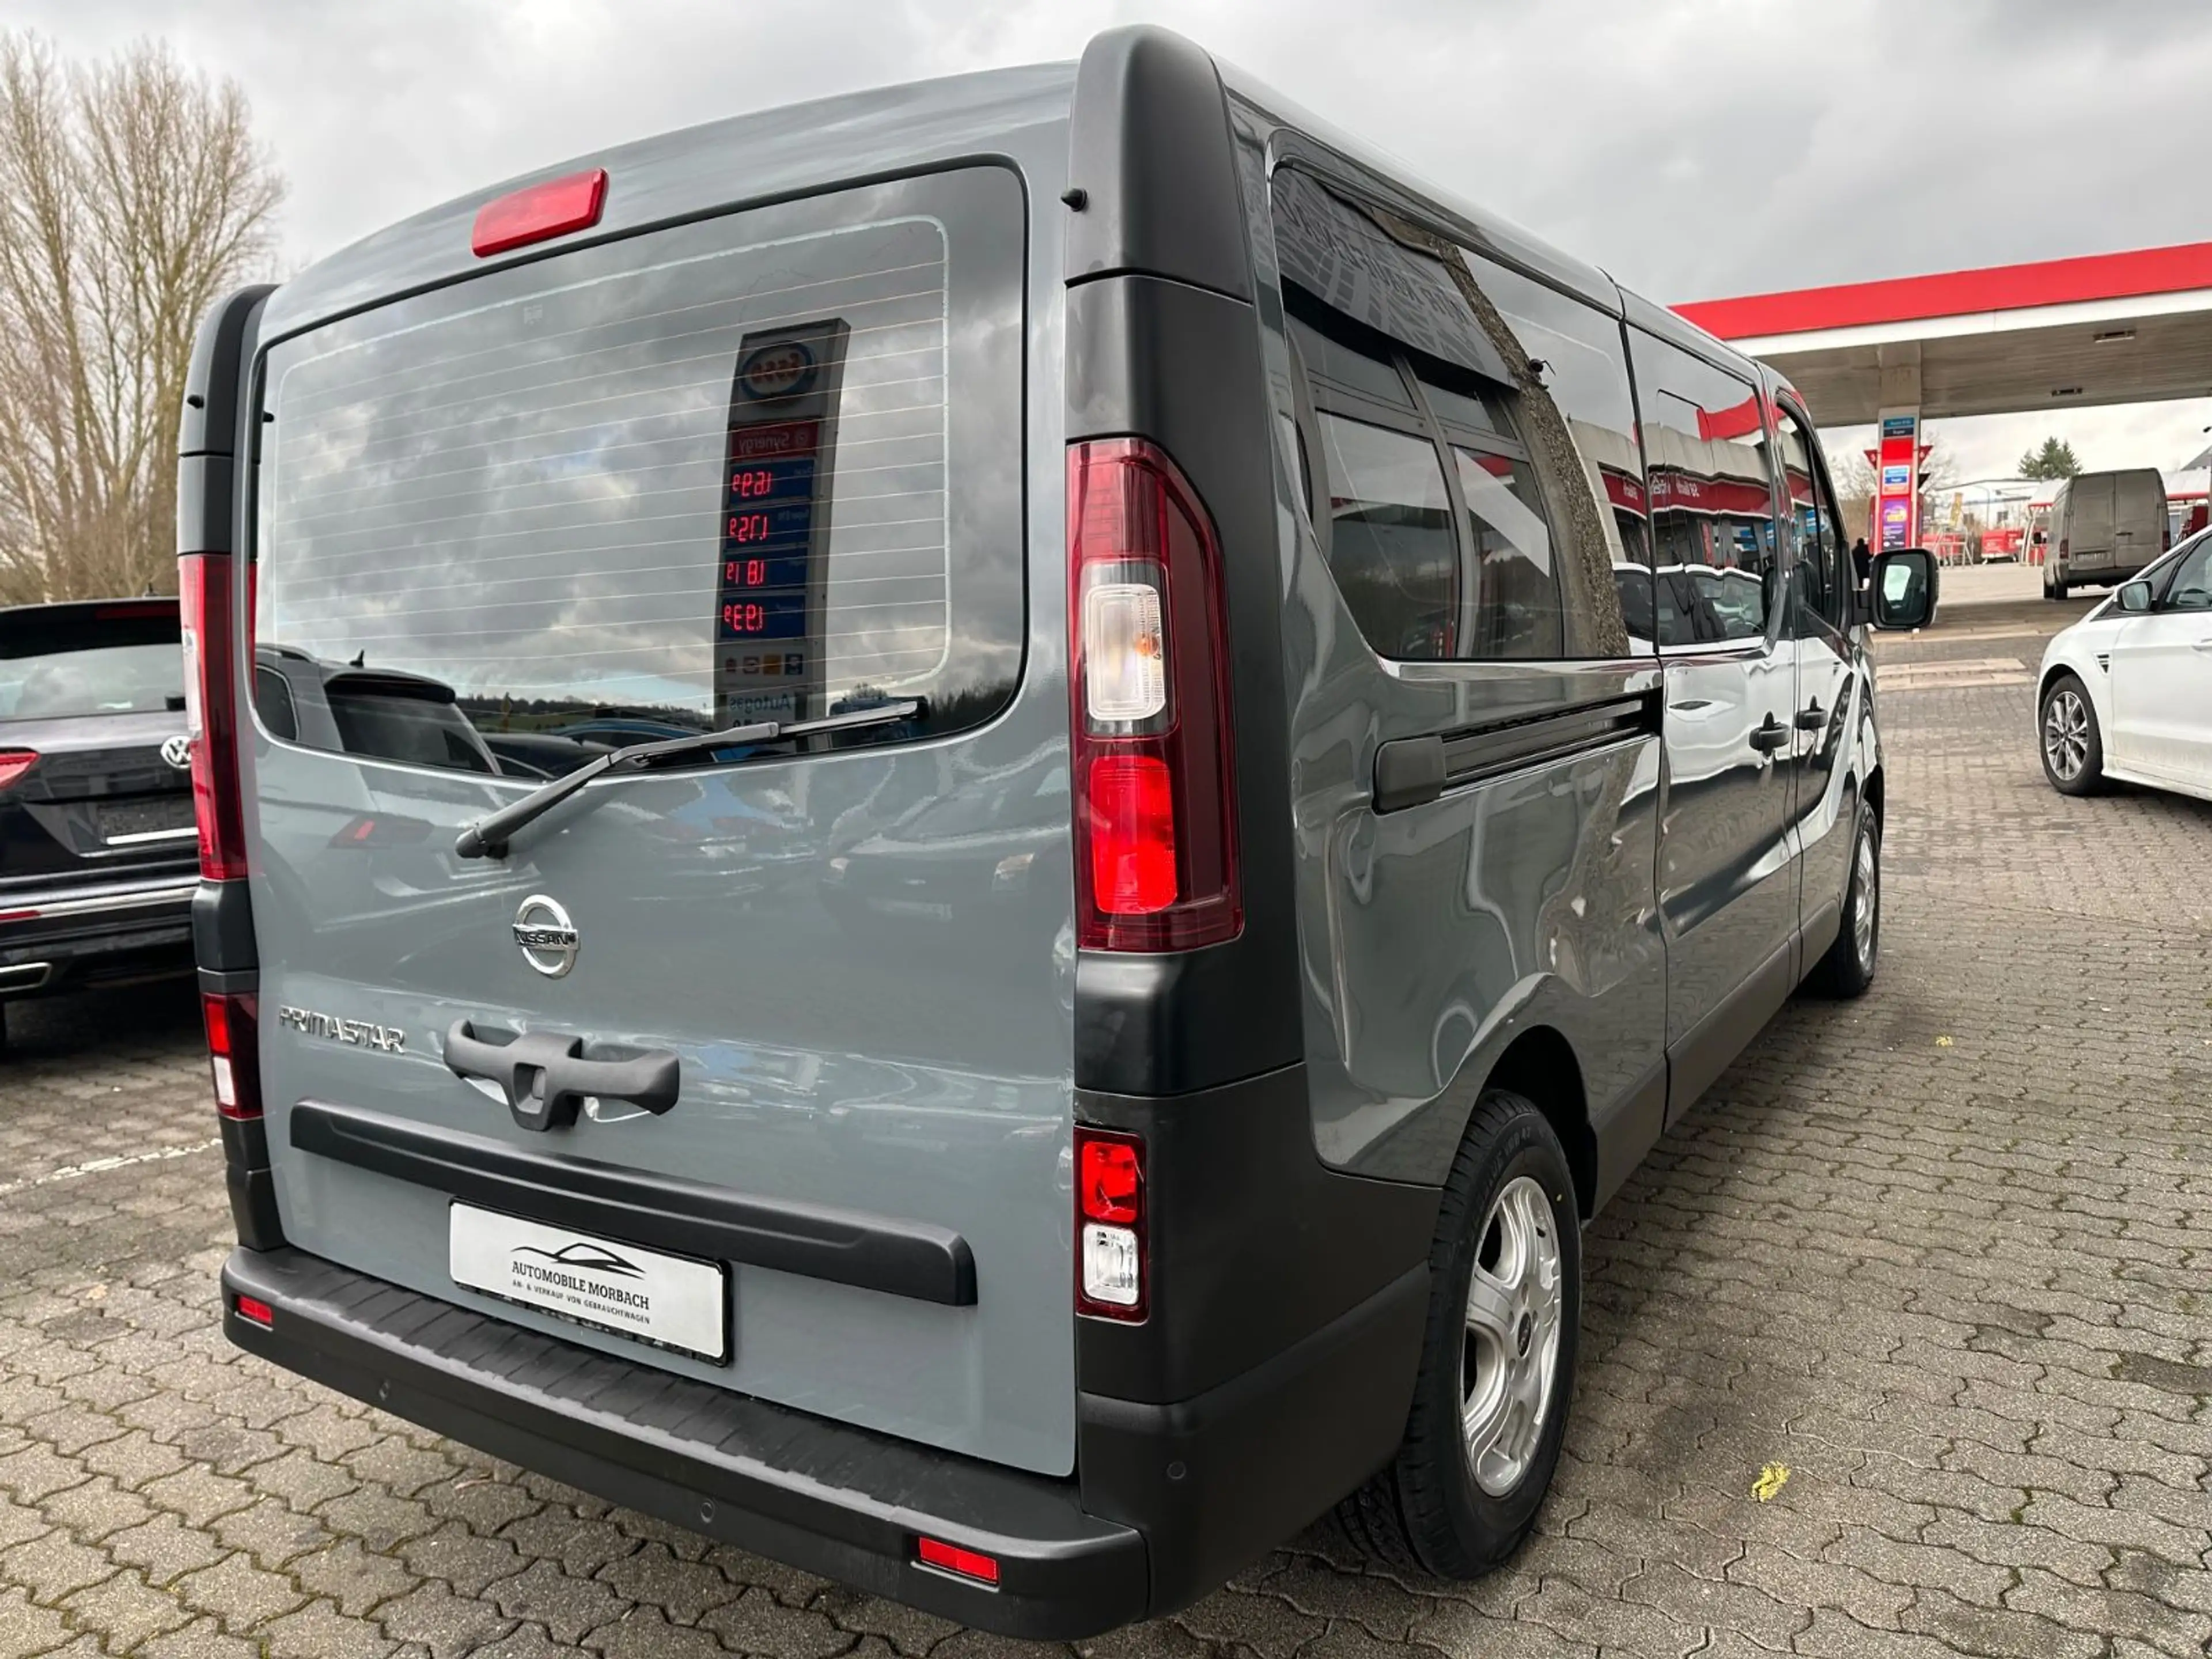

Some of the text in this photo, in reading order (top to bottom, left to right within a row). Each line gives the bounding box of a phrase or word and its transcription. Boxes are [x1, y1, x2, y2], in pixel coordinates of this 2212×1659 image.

[516, 931, 569, 948] NISSAN
[279, 1005, 406, 1054] PRIMASTAR
[512, 1260, 650, 1310] AUTOMOBILE MORBACH
[534, 1285, 564, 1300] VERKAUF
[567, 1294, 582, 1305] VON
[584, 1299, 650, 1324] GEBRAUCHTWAGEN
